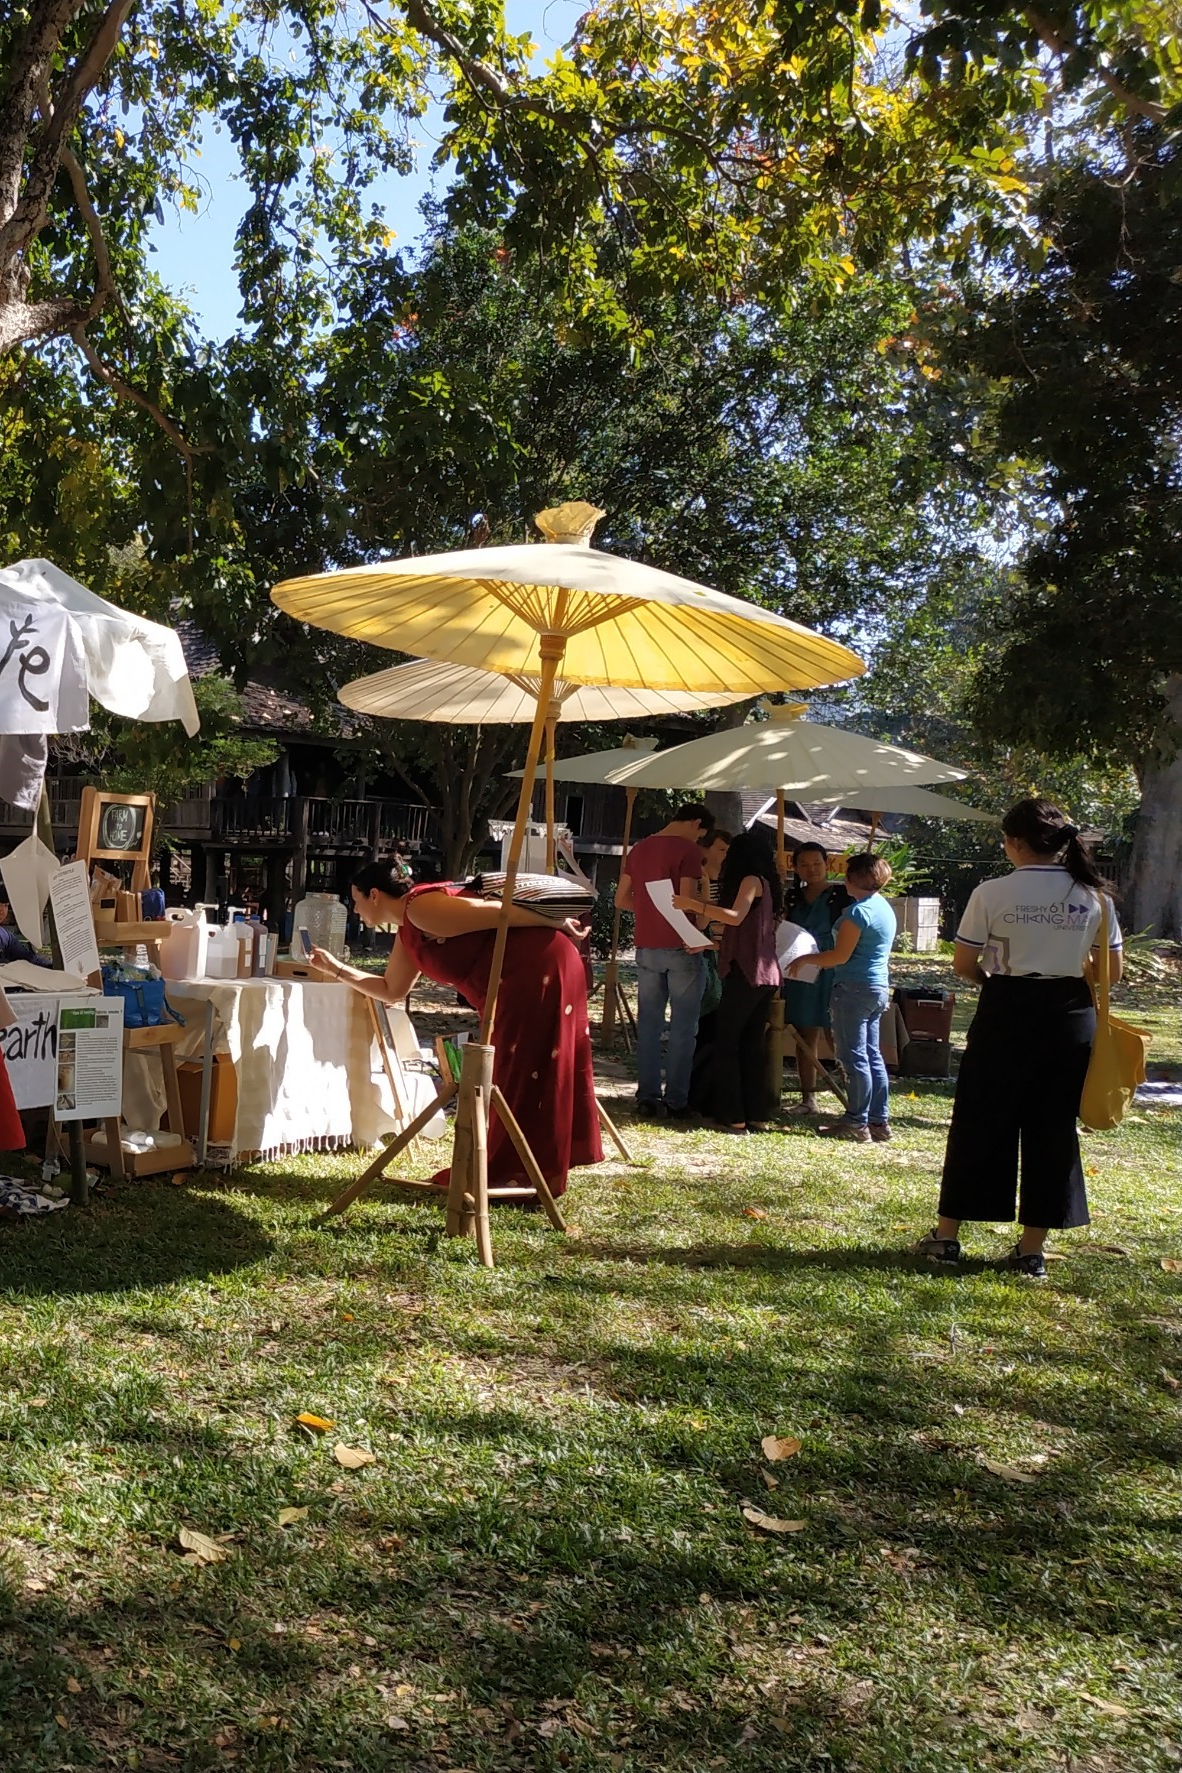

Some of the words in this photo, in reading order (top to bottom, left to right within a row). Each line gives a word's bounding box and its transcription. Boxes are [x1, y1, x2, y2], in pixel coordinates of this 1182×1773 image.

[111, 809, 129, 822] FARM
[109, 829, 128, 842] HOME
[1015, 905, 1048, 913] FRESHY
[1049, 902, 1065, 914] 61
[1003, 913, 1064, 924] CHIANG
[1067, 914, 1089, 925] MA
